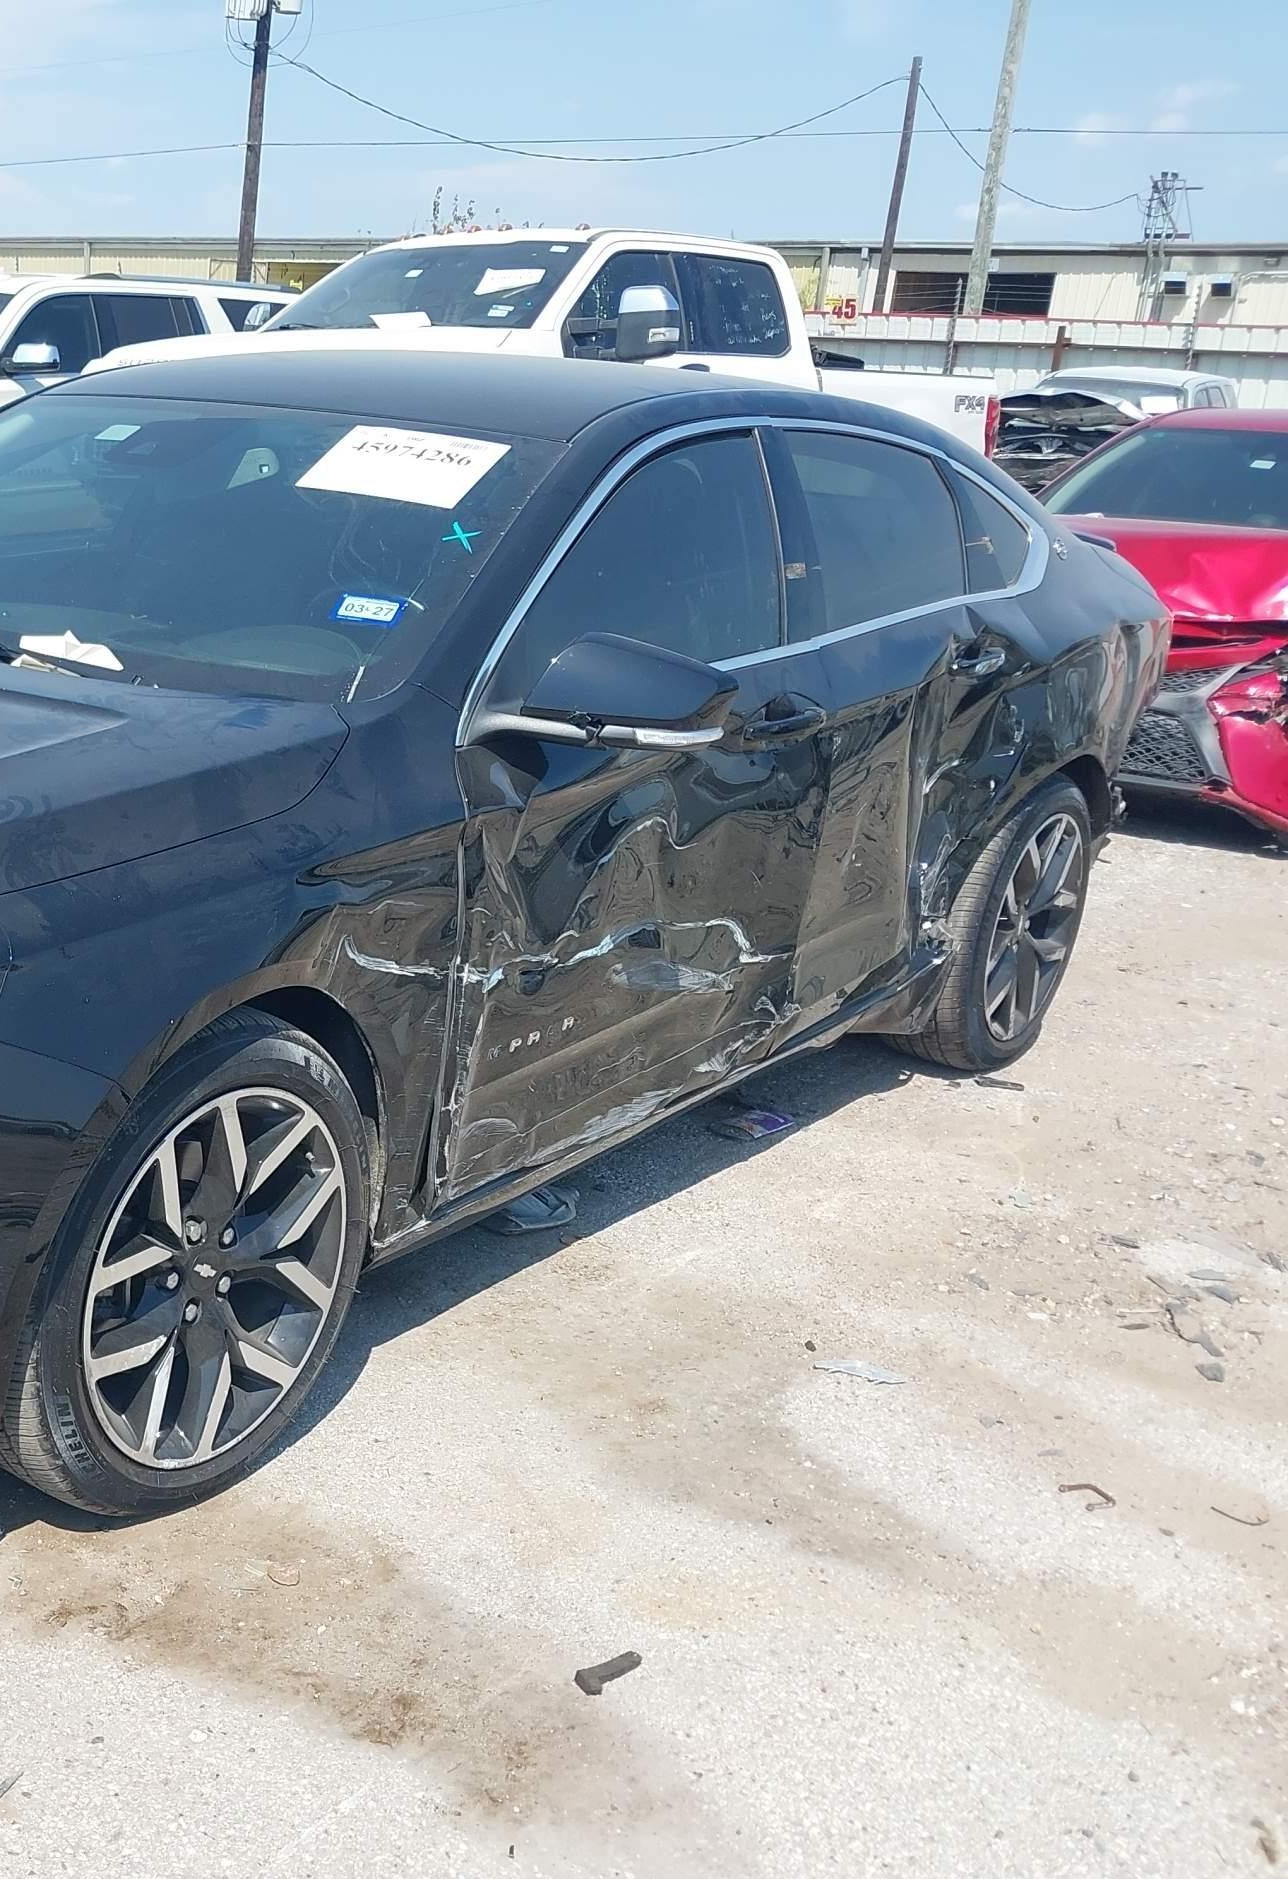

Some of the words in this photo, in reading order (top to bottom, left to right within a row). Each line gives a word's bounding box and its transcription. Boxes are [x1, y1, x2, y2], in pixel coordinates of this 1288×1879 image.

[831, 298, 857, 319] 45
[953, 394, 986, 413] FX4
[352, 440, 473, 467] 45974286
